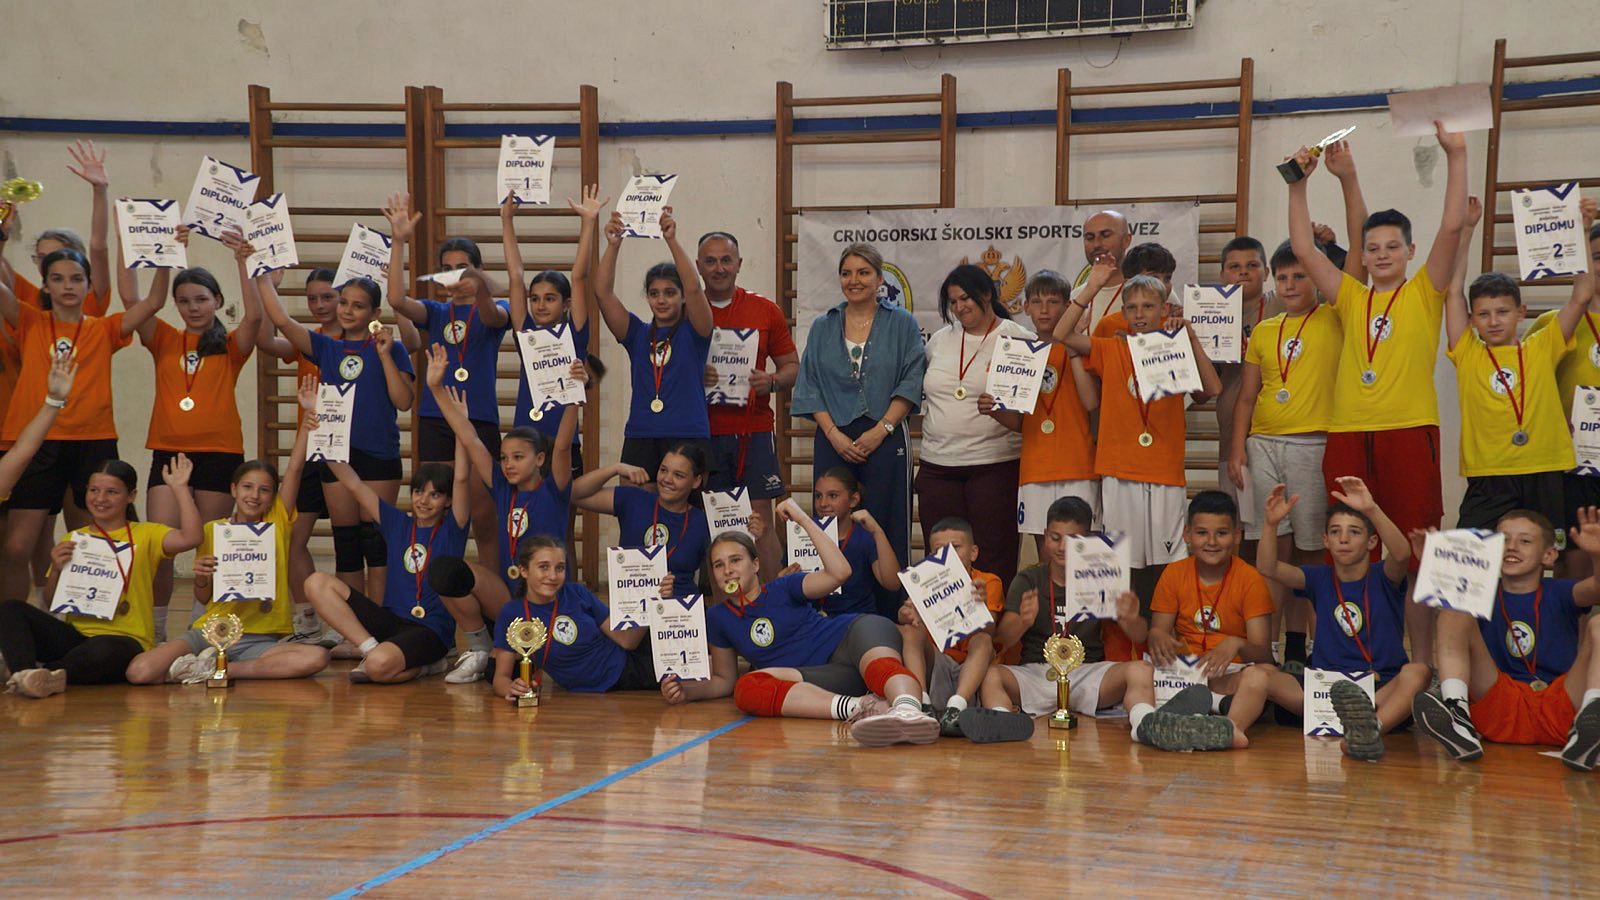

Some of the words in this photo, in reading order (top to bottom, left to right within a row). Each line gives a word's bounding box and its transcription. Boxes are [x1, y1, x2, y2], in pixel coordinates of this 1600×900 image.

[505, 160, 544, 168] DIPLOMU
[523, 176, 530, 189] 1
[200, 187, 244, 208] DIPLOMU
[625, 194, 662, 202] DIPLOMU
[213, 213, 224, 225] 2
[640, 210, 646, 223] 1
[128, 226, 174, 235] DIPLOMU
[248, 223, 284, 240] DIPLOMU
[833, 228, 937, 242] CRNOGORSKI
[942, 224, 1013, 240] ŠKOLSKI
[1018, 225, 1082, 240] SPORTS
[1524, 220, 1574, 235] DIPLOMU
[154, 243, 164, 254] 2
[268, 244, 276, 256] 1
[1552, 243, 1563, 258] 2
[1190, 315, 1234, 324] DIPLOMU
[1212, 334, 1219, 348] 1
[532, 356, 572, 370] DIPLOMU
[712, 356, 749, 365] DIPLOMU
[1142, 352, 1186, 367] DIPLOMU
[996, 364, 1036, 377] DIPLOMU
[1168, 370, 1176, 381] 1
[557, 377, 564, 390] 1
[728, 374, 736, 386] 2
[1012, 384, 1018, 397] 1
[328, 433, 334, 446] 1
[714, 516, 748, 528] DIPLOMU
[222, 553, 268, 562] DIPLOMU
[794, 548, 818, 558] DIPLO
[1434, 547, 1490, 570] DIPLOMU
[70, 564, 118, 580] DIPLOMU
[245, 572, 254, 584] 3
[1074, 567, 1122, 579] DIPLOMU
[617, 578, 660, 588] DIPLOMU
[1456, 576, 1468, 593] 3
[86, 587, 97, 600] 3
[923, 579, 965, 609] DIPLOMU
[1098, 590, 1105, 604] 1
[640, 598, 646, 612] 1
[954, 605, 965, 619] 1
[658, 629, 699, 640] DIPLOMU
[680, 650, 687, 664] 1
